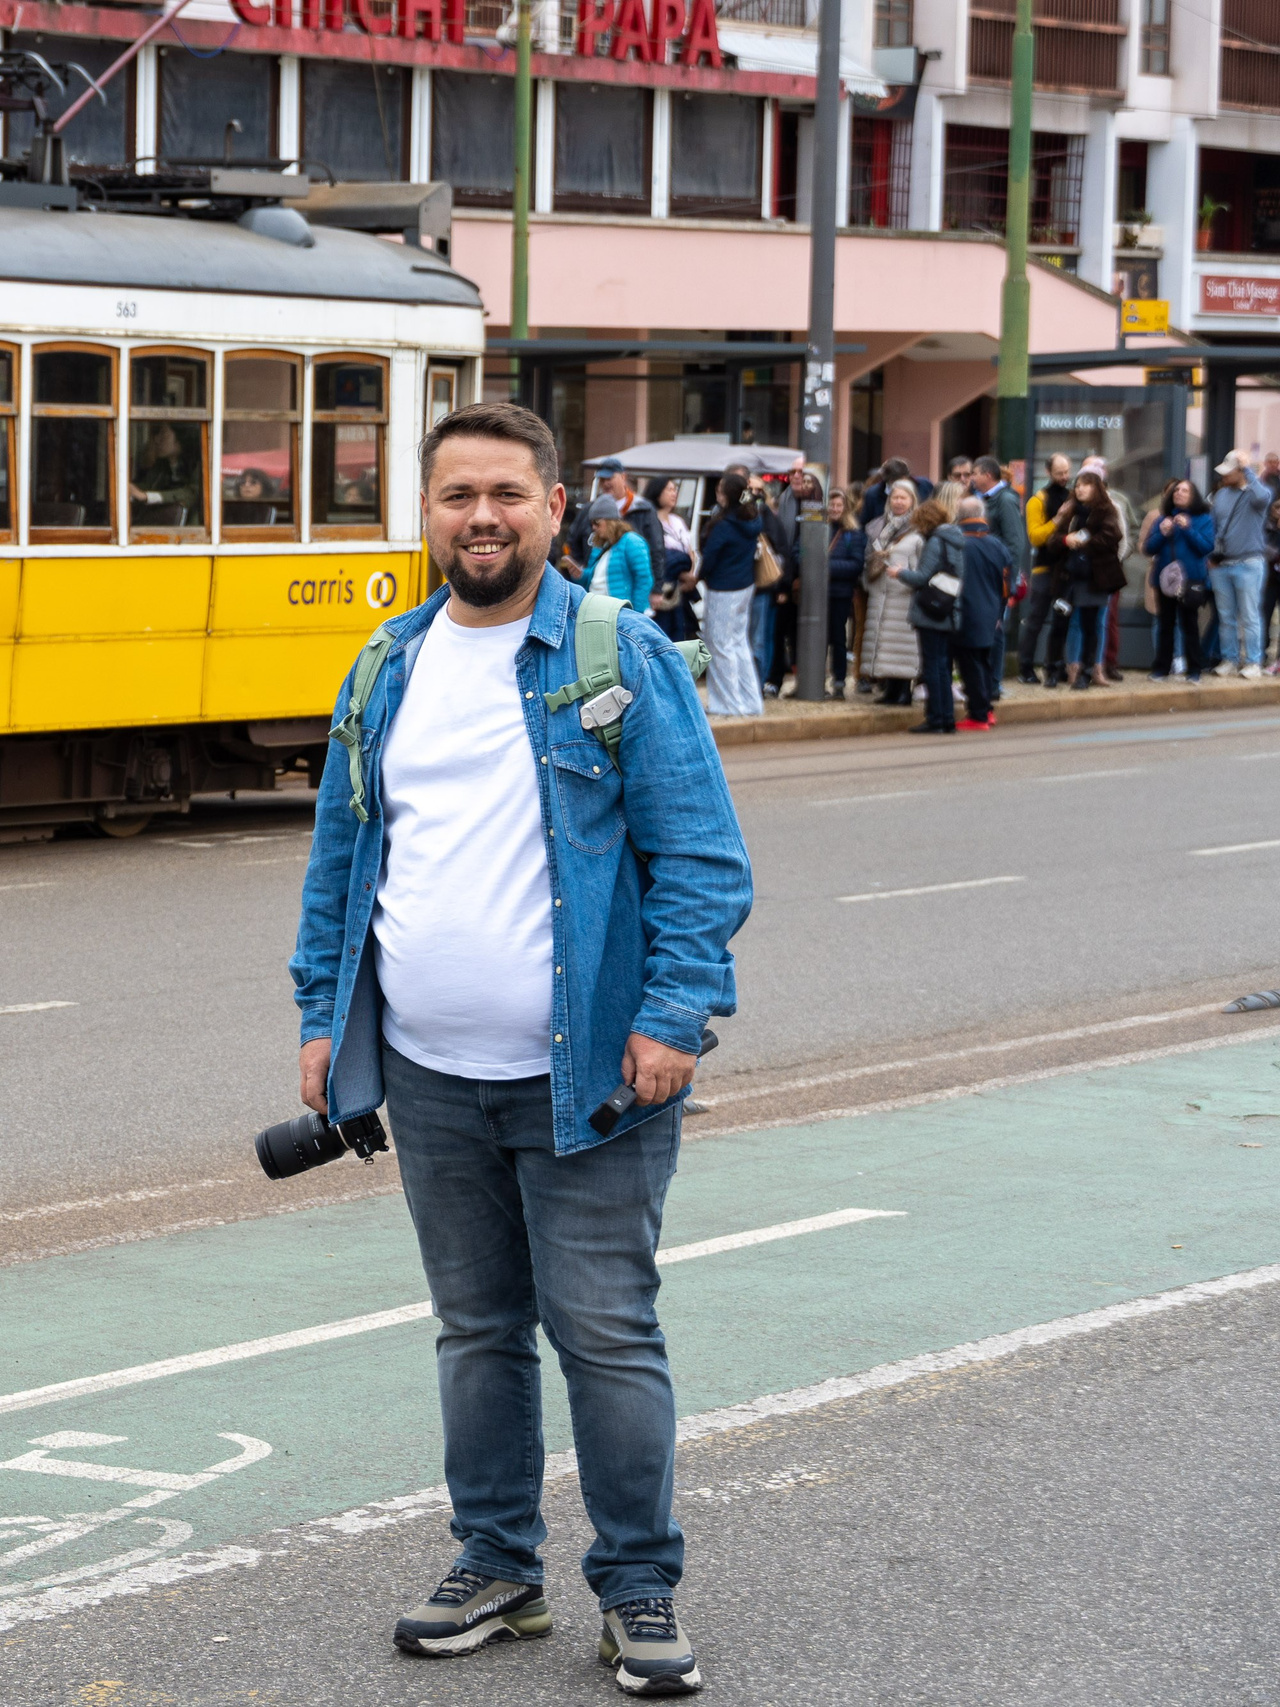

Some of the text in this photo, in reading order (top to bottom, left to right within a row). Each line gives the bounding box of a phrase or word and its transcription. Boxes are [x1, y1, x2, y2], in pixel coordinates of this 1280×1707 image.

[577, 0, 722, 68] PAPA
[116, 301, 137, 318] 563
[1040, 414, 1123, 430] Novo Kia EV3
[287, 568, 354, 606] carris
[464, 1585, 530, 1625] GOODYEAR
